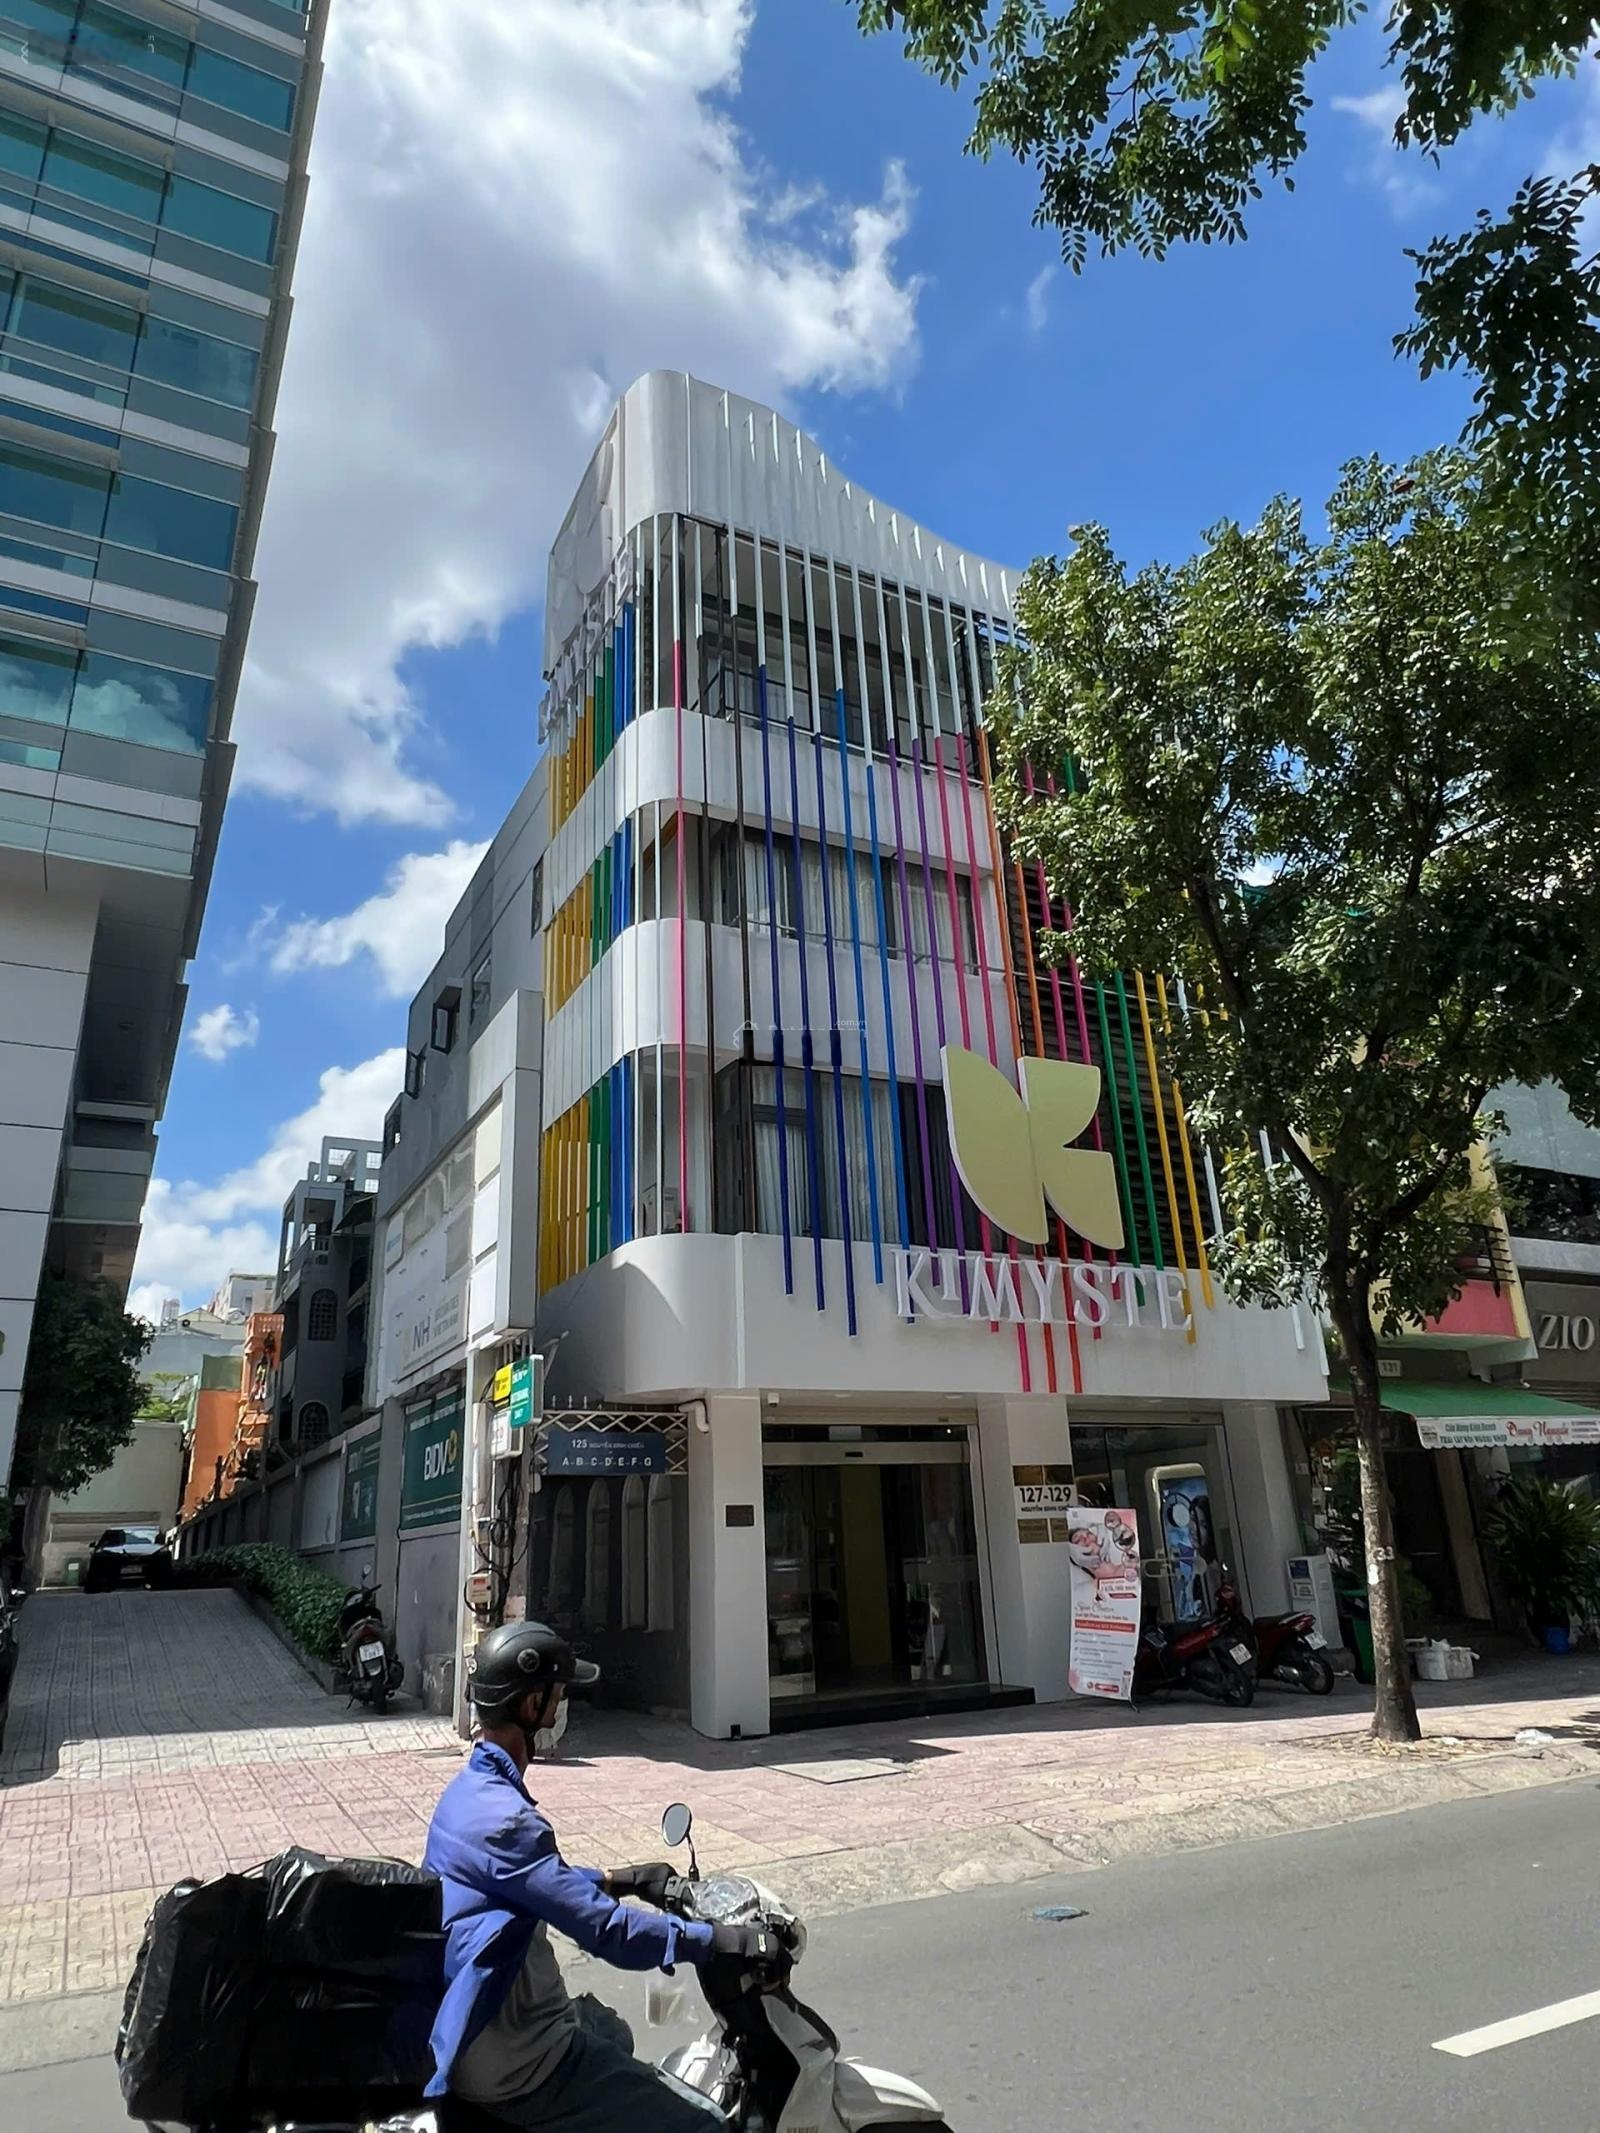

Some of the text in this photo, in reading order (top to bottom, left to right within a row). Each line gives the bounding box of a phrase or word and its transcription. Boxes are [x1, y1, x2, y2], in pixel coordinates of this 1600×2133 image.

[892, 1249, 1192, 1330] KIMYSTE
[572, 1439, 588, 1449] 125
[1020, 1486, 1071, 1503] 127-129
